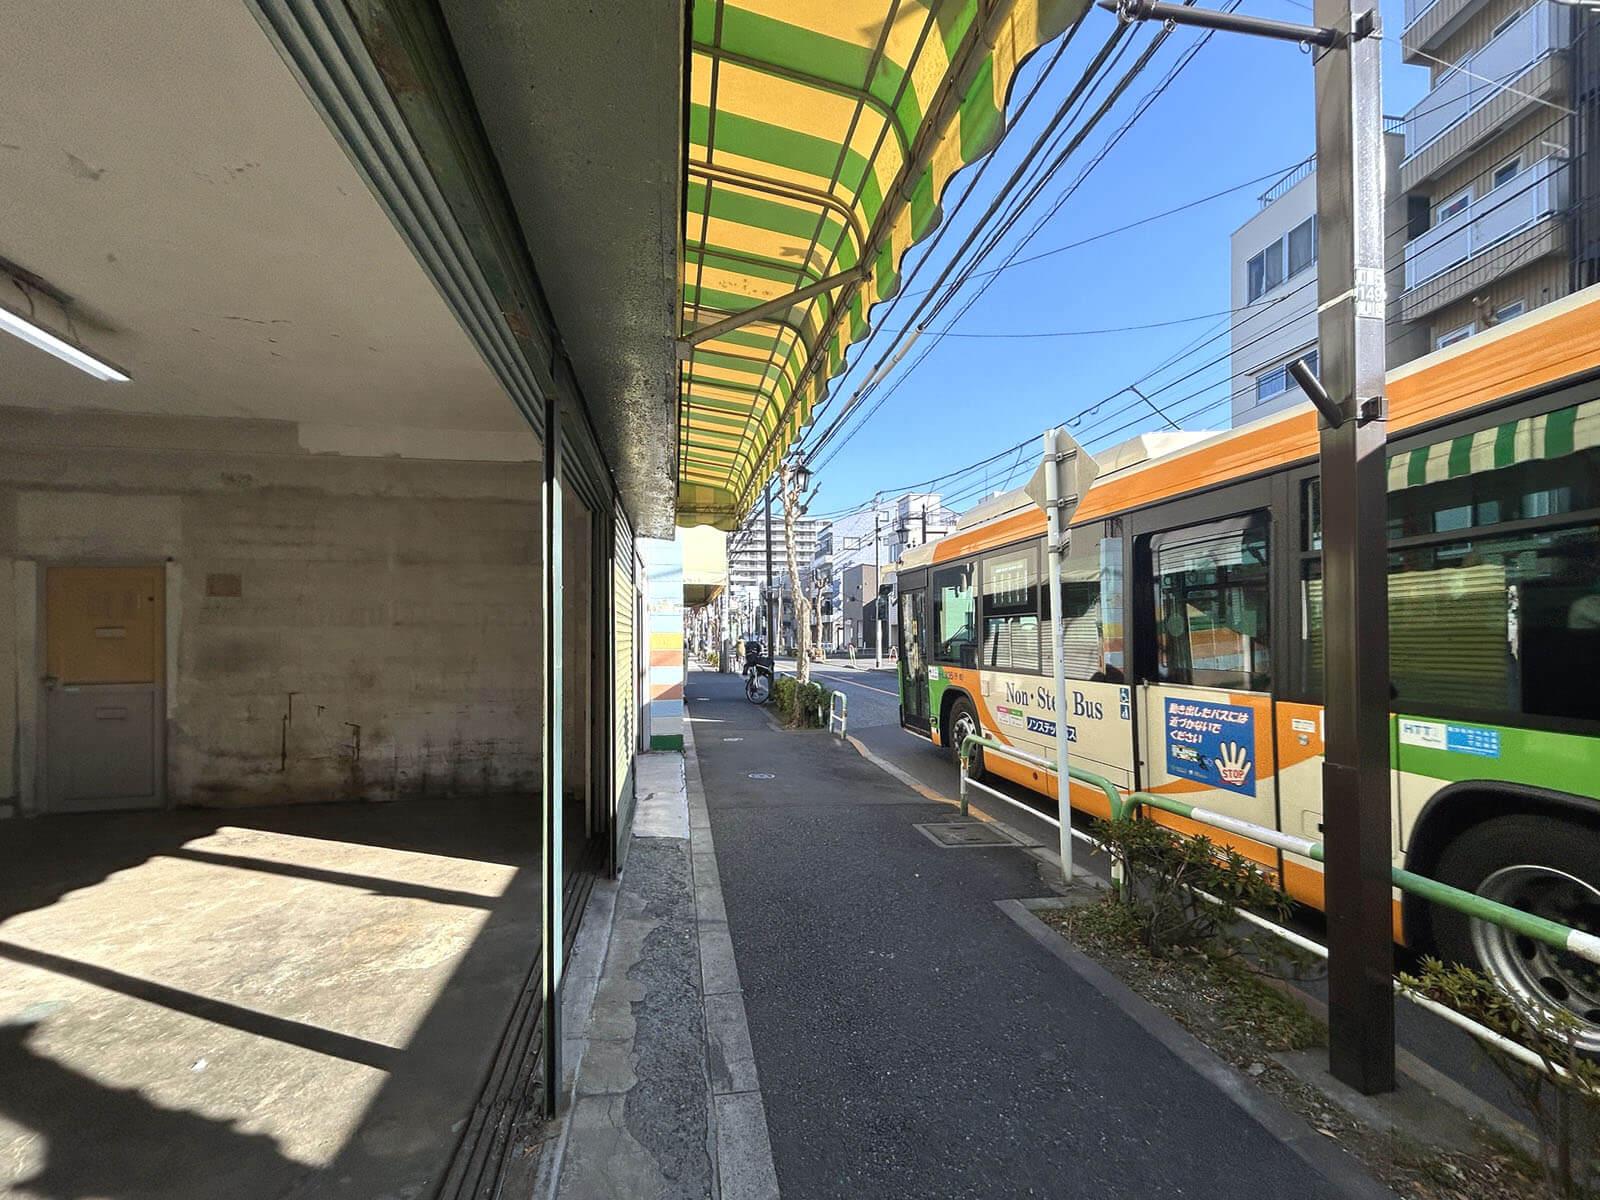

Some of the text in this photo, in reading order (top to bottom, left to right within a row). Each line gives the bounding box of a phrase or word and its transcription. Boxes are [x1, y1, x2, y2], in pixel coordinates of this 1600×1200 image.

[1072, 690, 1103, 720] Bus
[1028, 719, 1077, 740] ノンステッス
[1169, 716, 1222, 734] 近づかないで
[1170, 730, 1202, 743] ください
[1222, 769, 1245, 779] STOP
